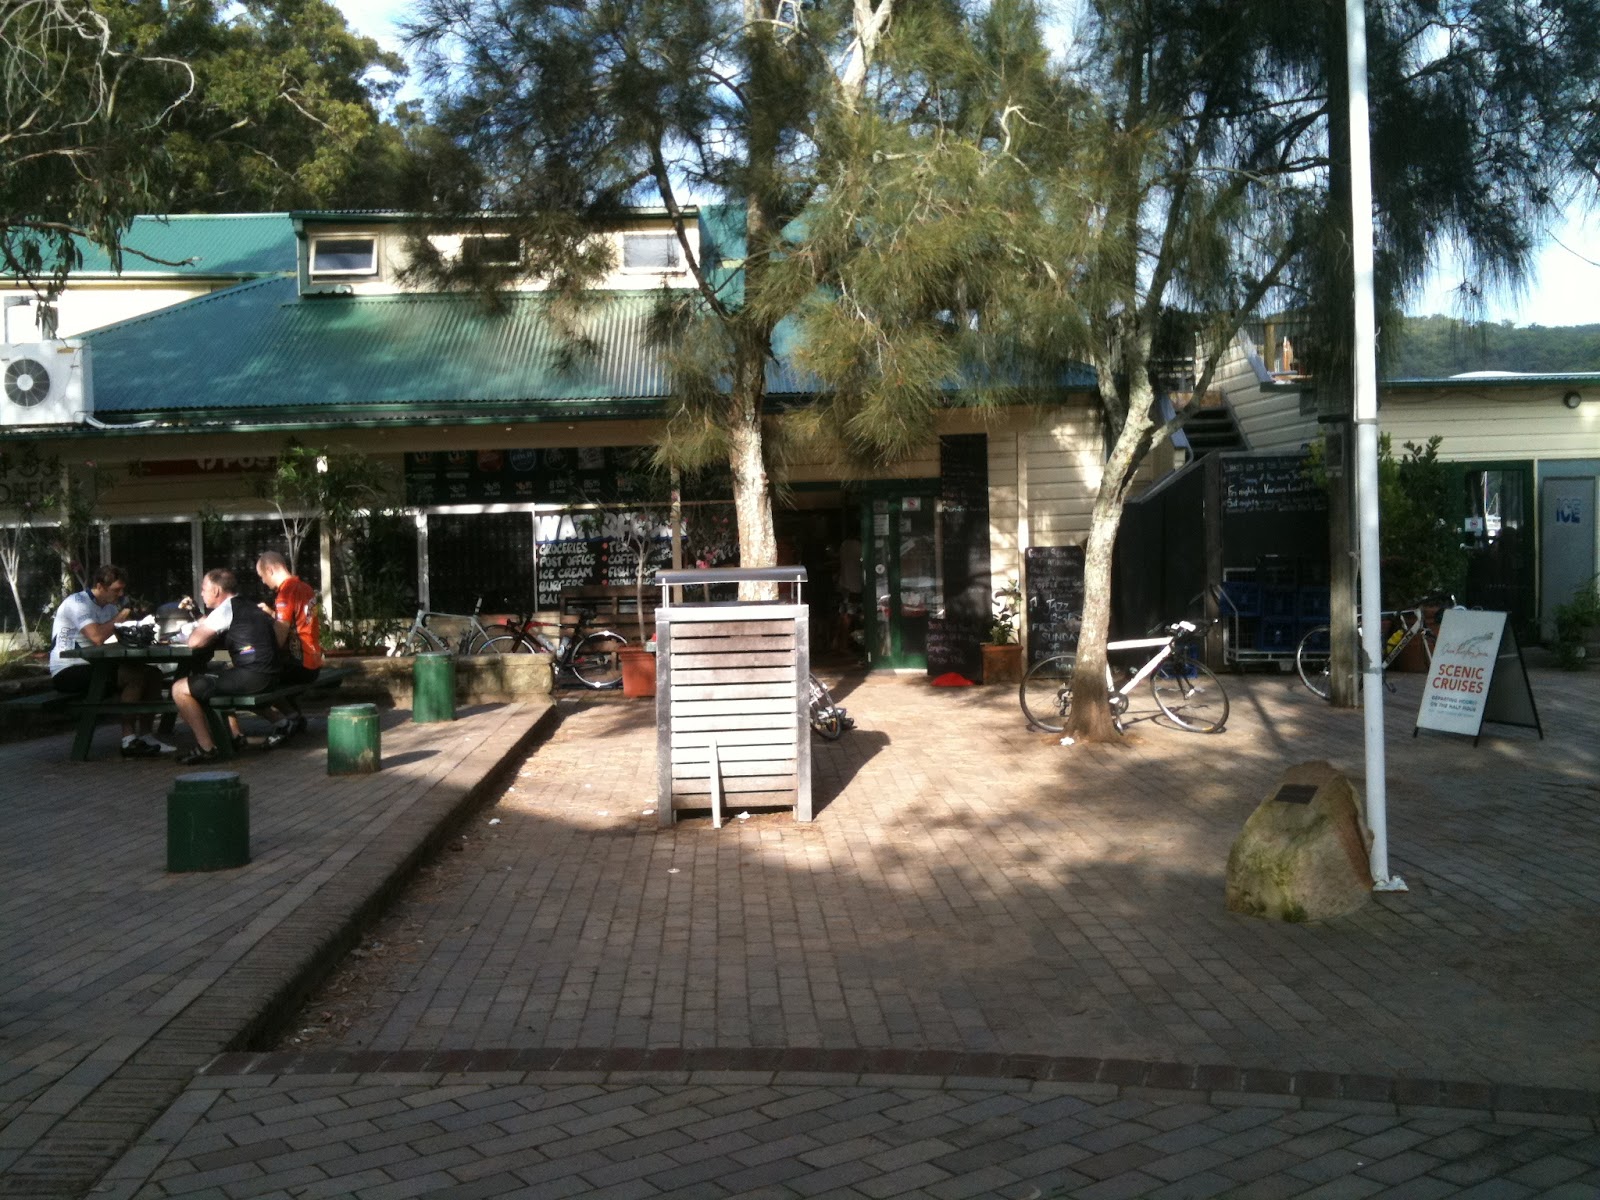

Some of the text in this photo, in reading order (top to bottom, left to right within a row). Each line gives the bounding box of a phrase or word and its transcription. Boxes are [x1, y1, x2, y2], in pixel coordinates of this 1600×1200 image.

[1556, 498, 1581, 523] ICE
[538, 542, 588, 555] GROCERIES
[539, 553, 596, 568] POST OFFICE
[607, 553, 645, 565] COFFE
[538, 567, 593, 580] ICE CREAM
[538, 593, 560, 605] BAI
[1044, 598, 1069, 616] JAZZ
[1438, 663, 1484, 680] SCENIC
[1432, 676, 1484, 694] CRUISES
